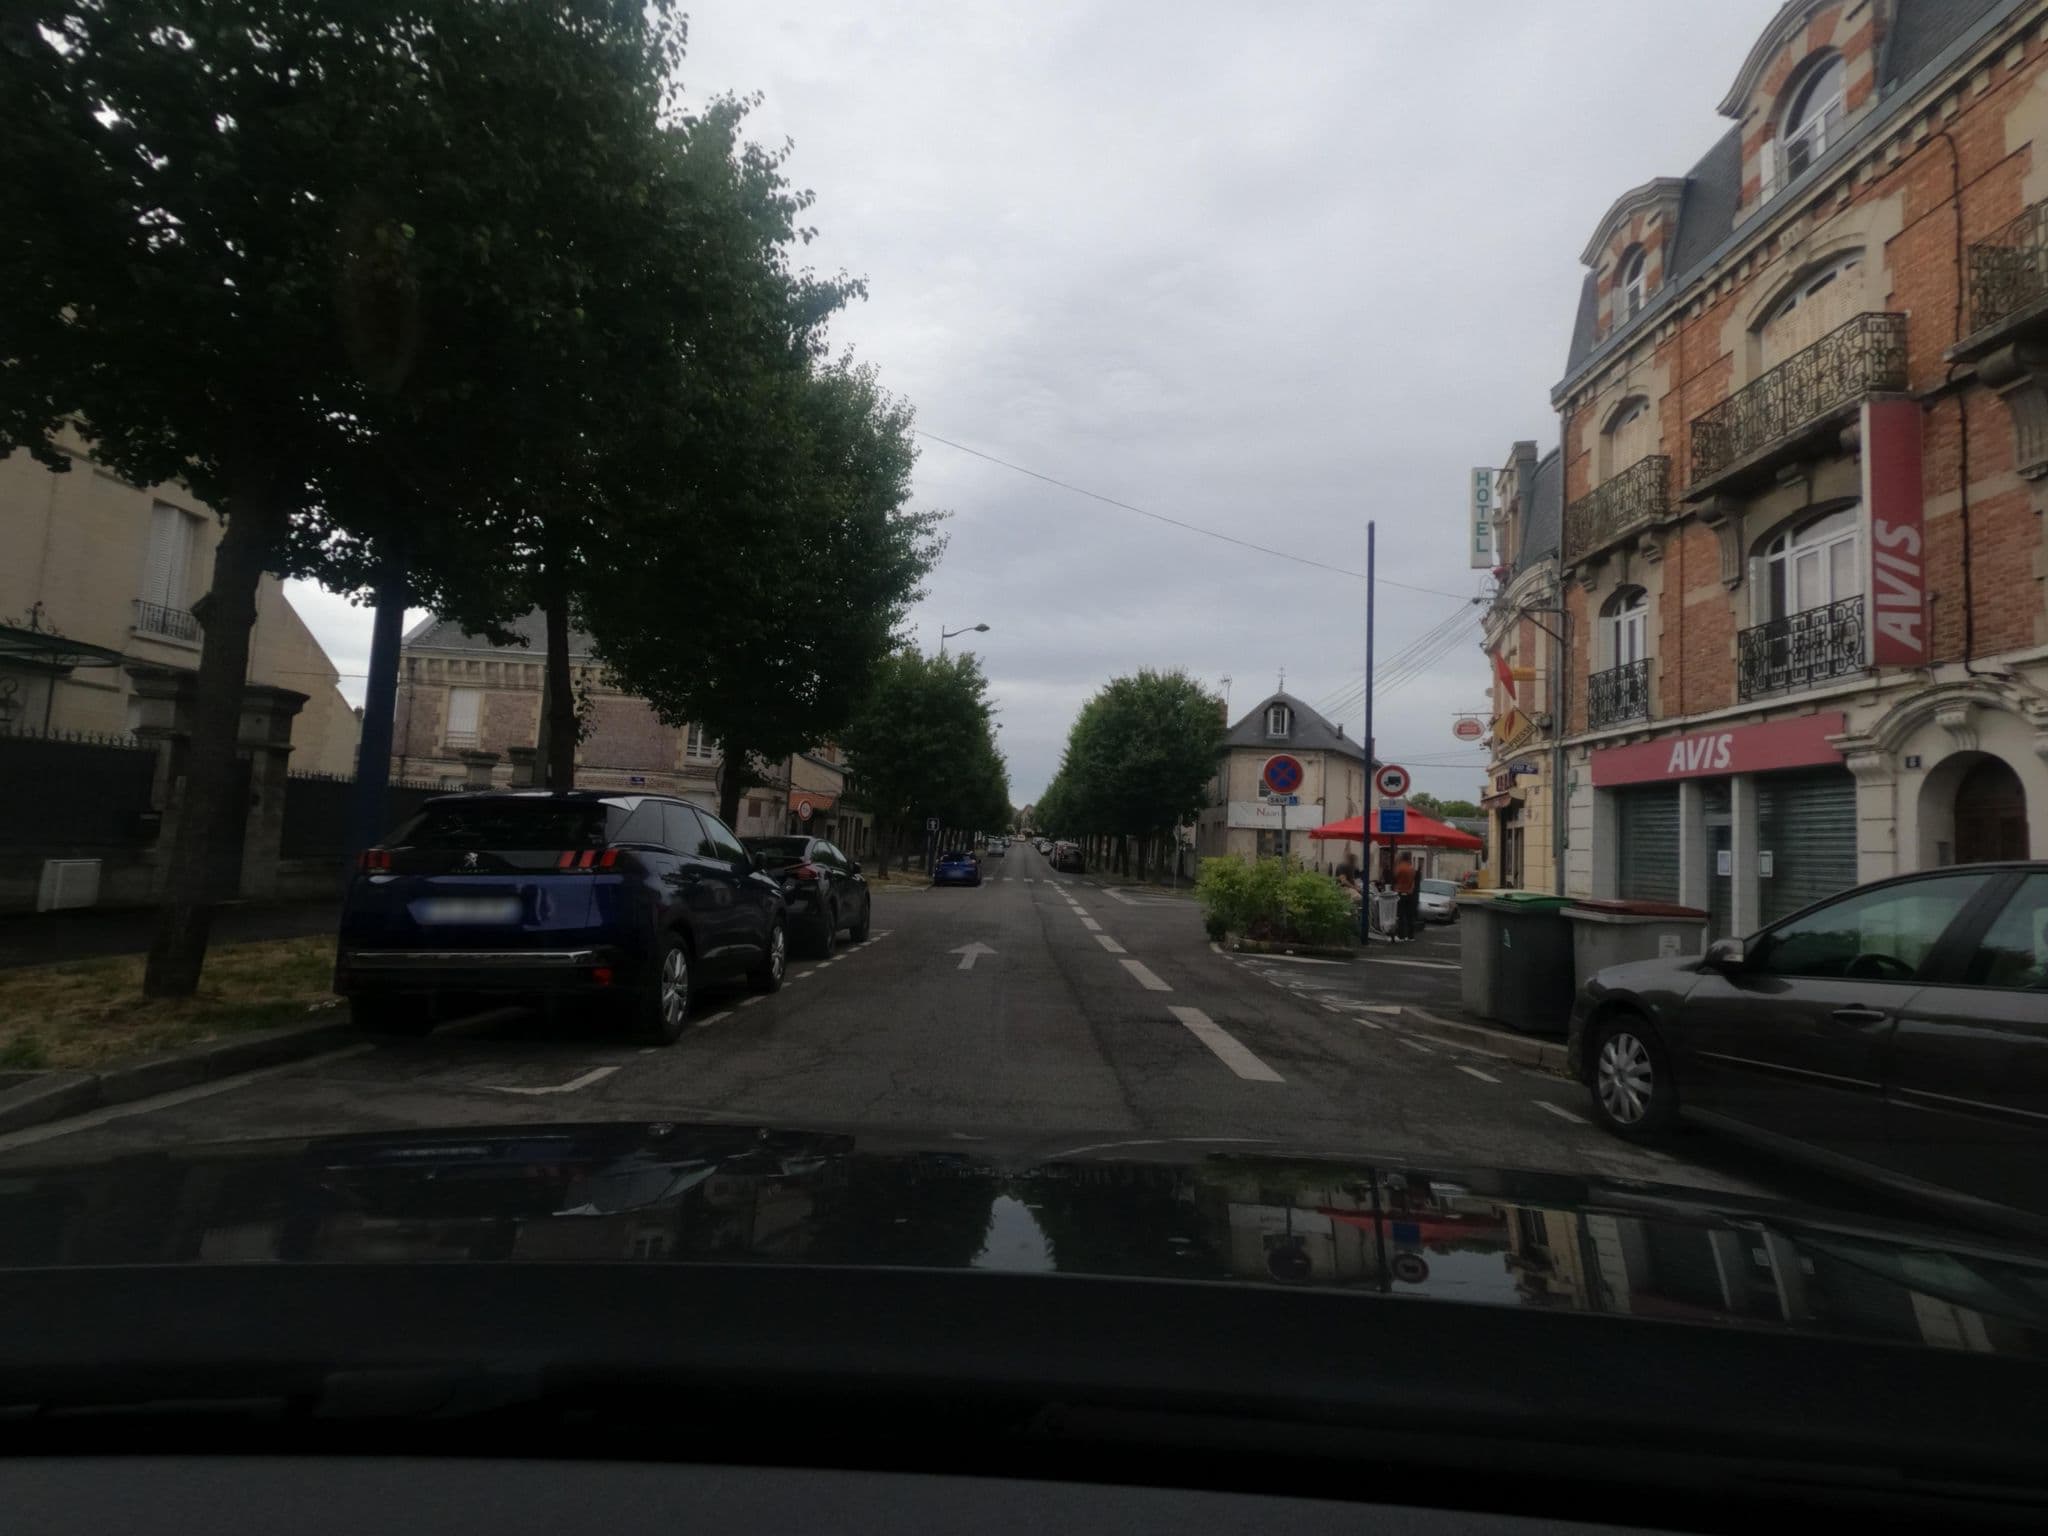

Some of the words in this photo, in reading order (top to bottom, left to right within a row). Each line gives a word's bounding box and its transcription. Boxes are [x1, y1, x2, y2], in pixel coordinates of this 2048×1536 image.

[1476, 471, 1489, 553] HOTEL
[1874, 518, 1922, 653] AVIS
[1667, 733, 1733, 773] AVIS
